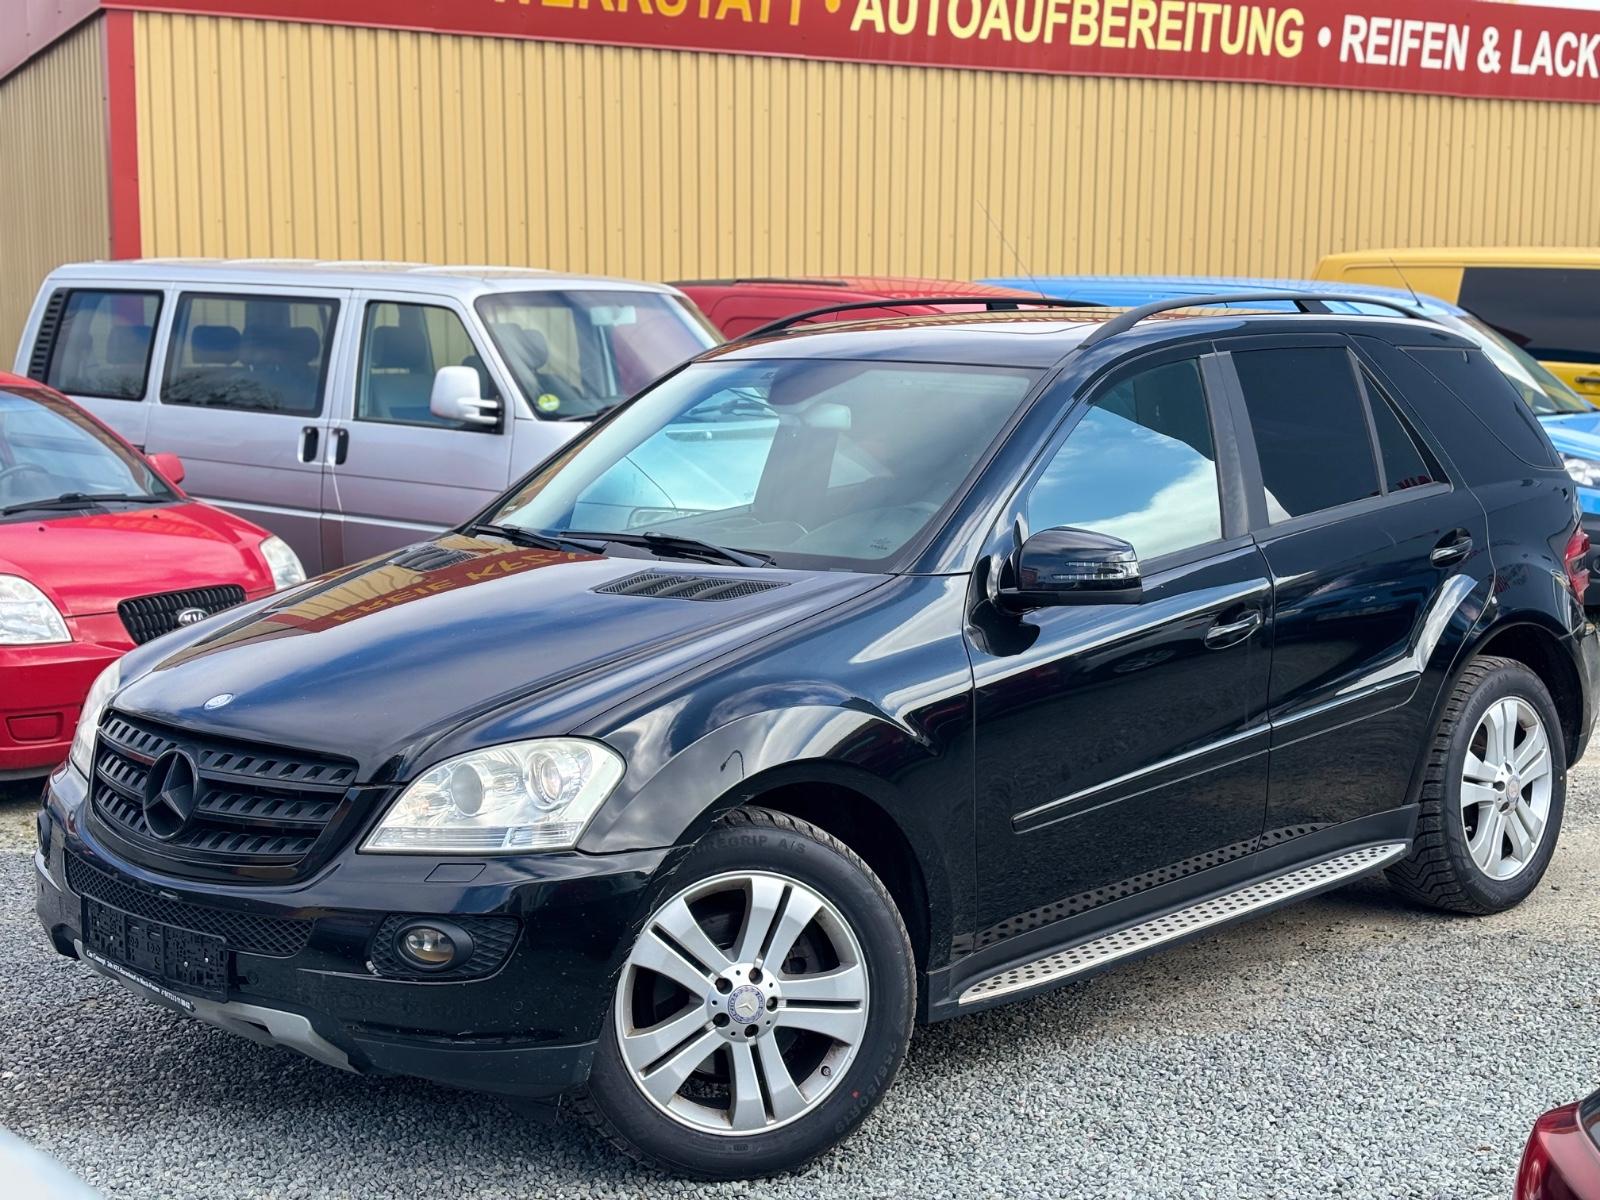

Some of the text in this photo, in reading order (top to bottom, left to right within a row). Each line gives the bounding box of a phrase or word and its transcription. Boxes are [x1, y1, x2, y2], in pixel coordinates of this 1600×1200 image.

[850, 0, 1305, 58] AUTOAUFBEREITUNG
[1339, 14, 1470, 71] REIFEN
[1477, 26, 1501, 74] &
[1510, 29, 1600, 79] LACK
[183, 612, 204, 624] KIA
